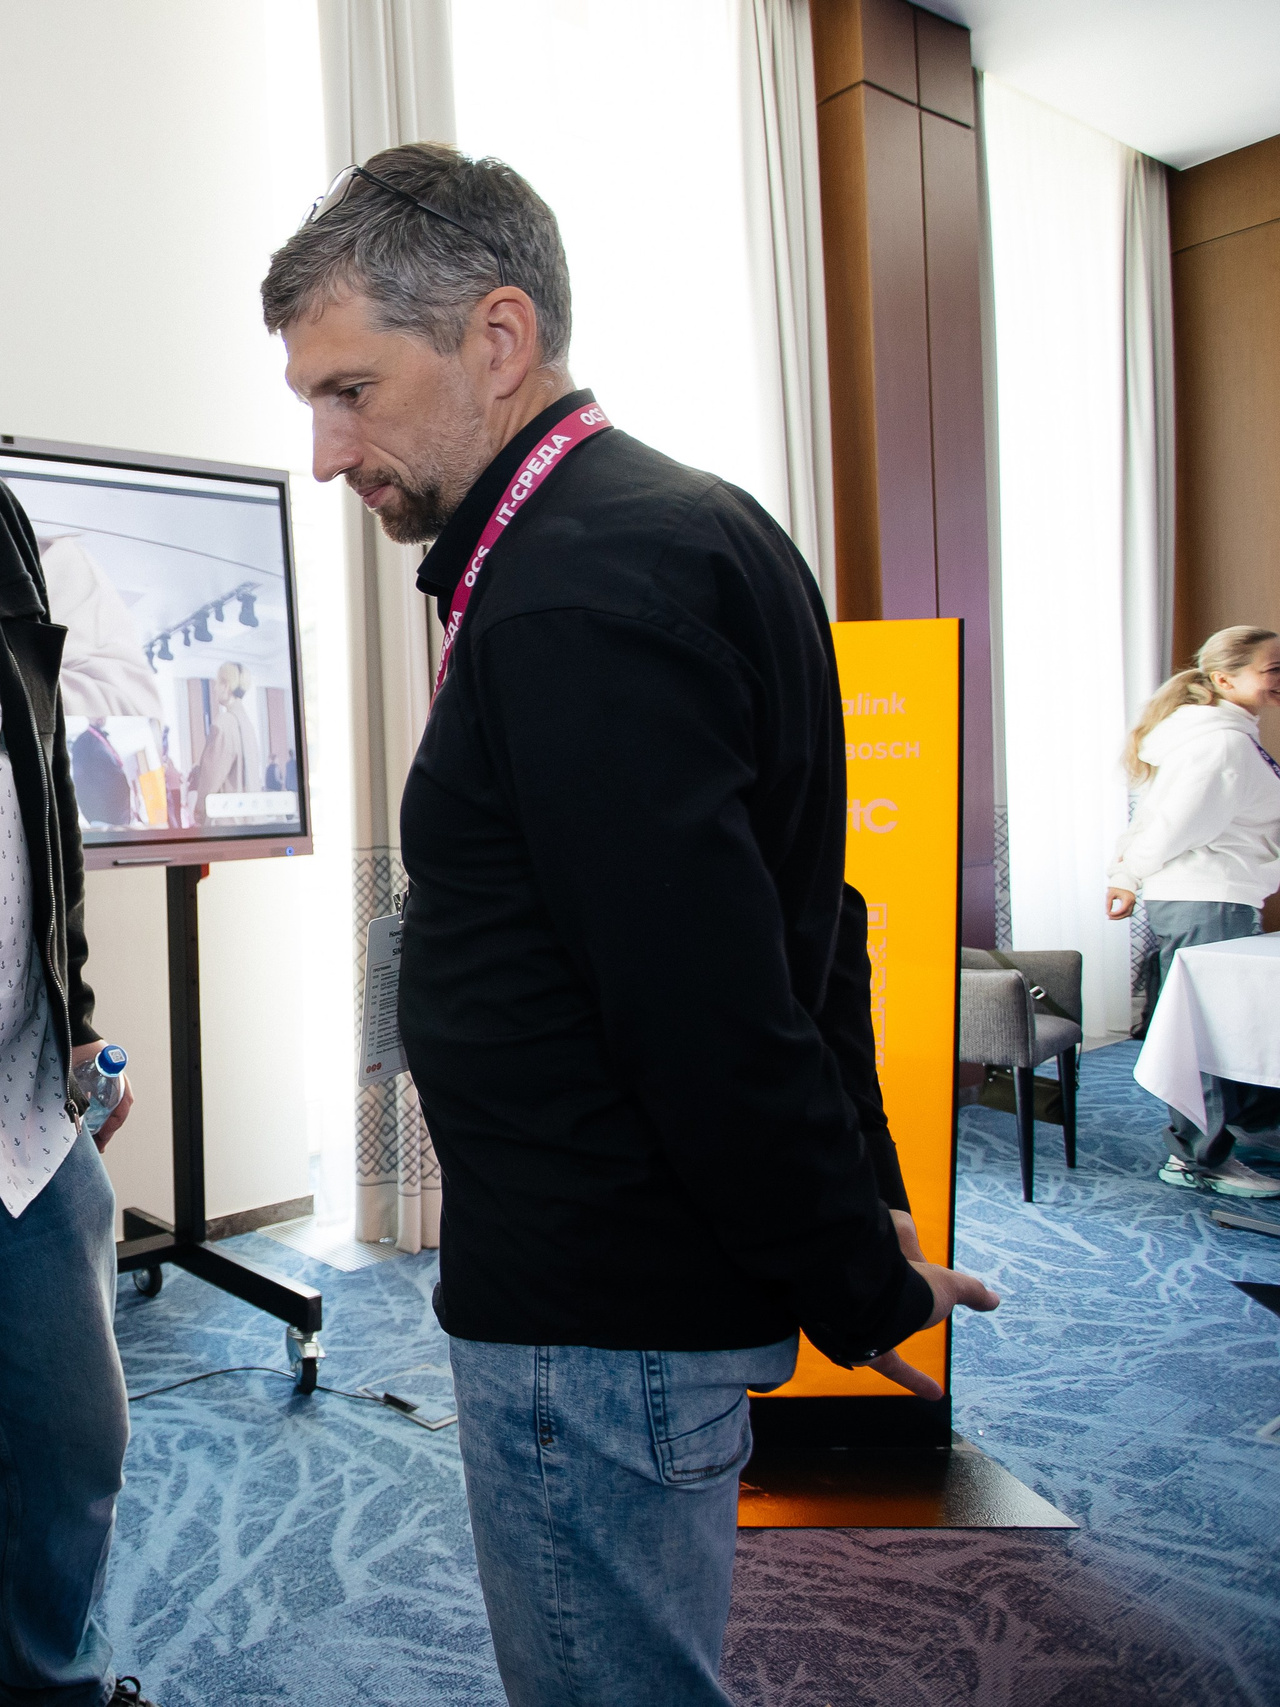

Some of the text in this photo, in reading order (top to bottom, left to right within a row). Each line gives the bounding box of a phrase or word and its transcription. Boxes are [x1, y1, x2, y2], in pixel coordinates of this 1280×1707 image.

[495, 433, 572, 527] IT-СРЕДА
[464, 545, 490, 587] OCS
[845, 741, 920, 760] BOSCH
